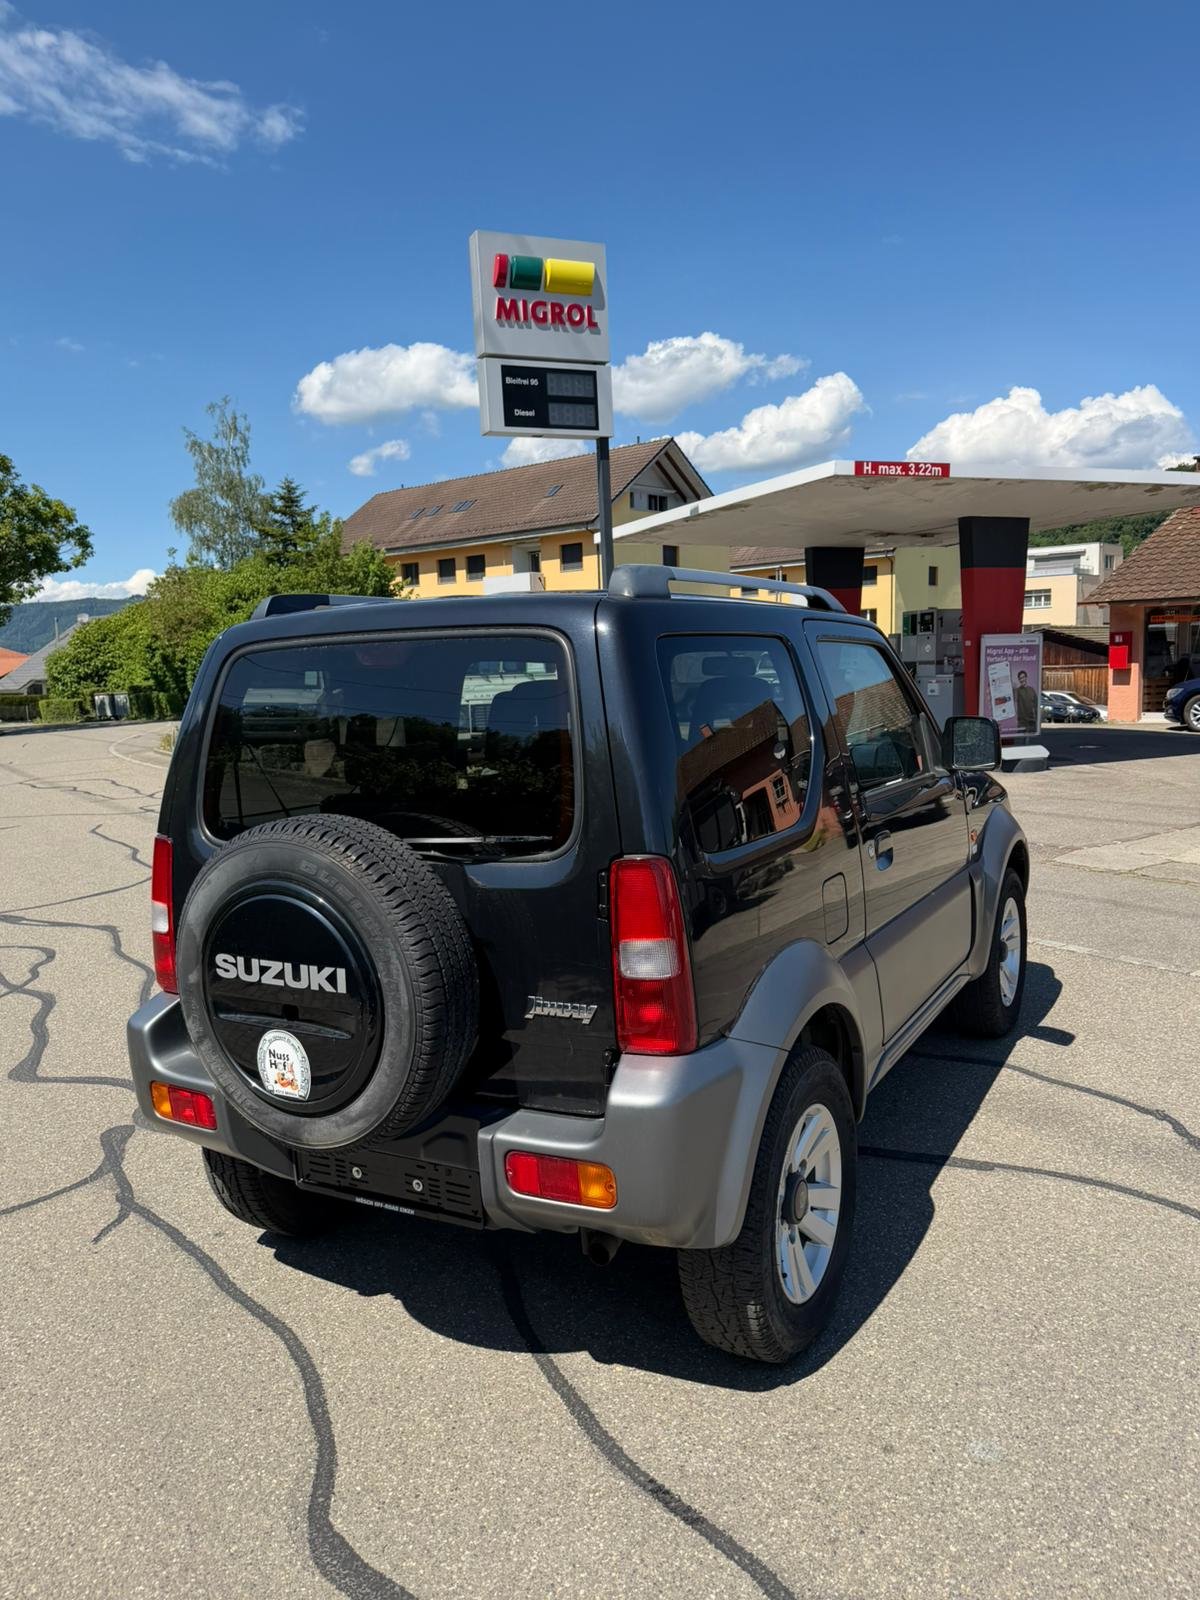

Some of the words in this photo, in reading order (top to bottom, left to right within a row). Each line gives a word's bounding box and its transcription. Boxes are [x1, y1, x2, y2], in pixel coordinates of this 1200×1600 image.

[496, 297, 598, 328] MIGROL
[505, 376, 529, 386] Bleifrei
[529, 378, 539, 387] 95
[514, 408, 535, 417] Diesel
[863, 462, 875, 475] H.
[878, 465, 906, 475] max.
[908, 463, 942, 476] 3.22m
[986, 647, 1003, 655] Migrol
[214, 953, 348, 994] SUZUKI
[268, 1049, 290, 1061] Nuss
